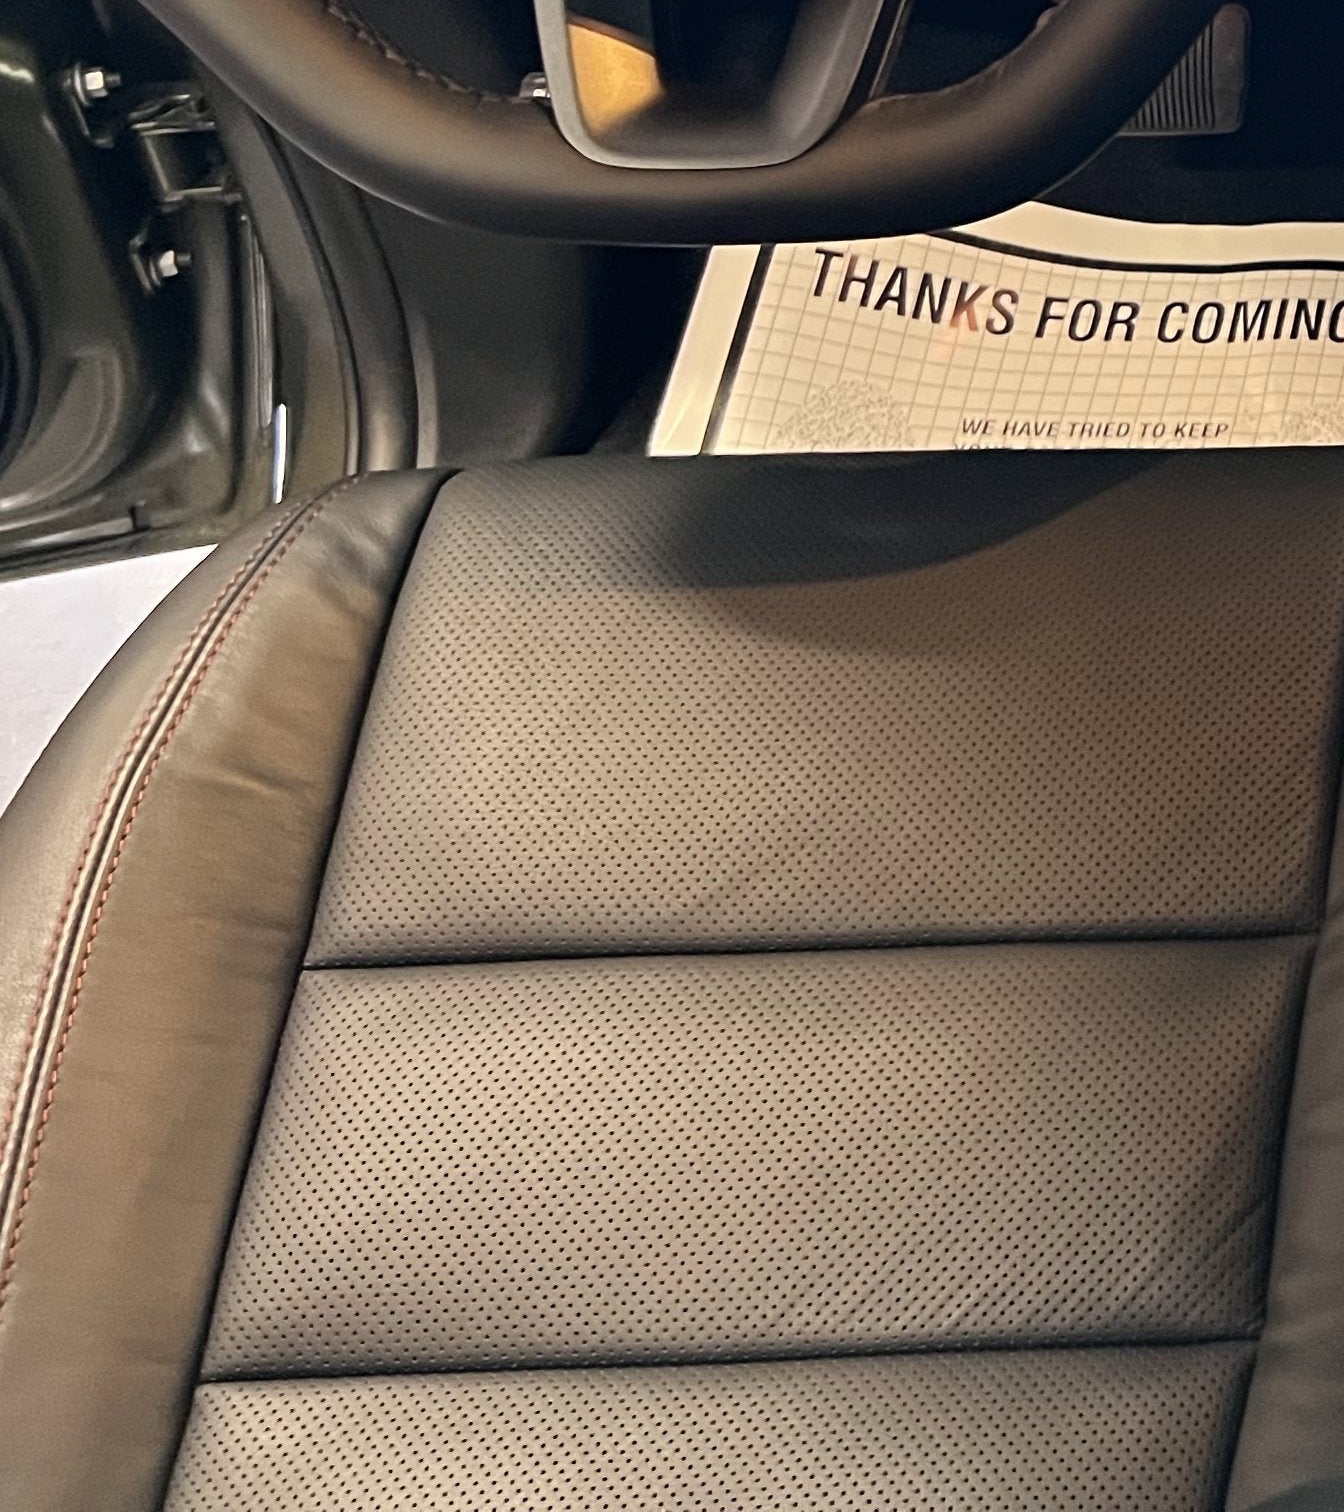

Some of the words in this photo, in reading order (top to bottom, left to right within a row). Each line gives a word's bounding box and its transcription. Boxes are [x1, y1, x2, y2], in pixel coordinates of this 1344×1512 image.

[813, 248, 1020, 336] THANKS
[1035, 295, 1142, 342] FOR
[961, 418, 996, 436] WE
[1001, 420, 1059, 438] HAVE
[1068, 422, 1130, 438] TRIED
[1140, 423, 1166, 438] TO
[1174, 422, 1230, 439] KEEP
